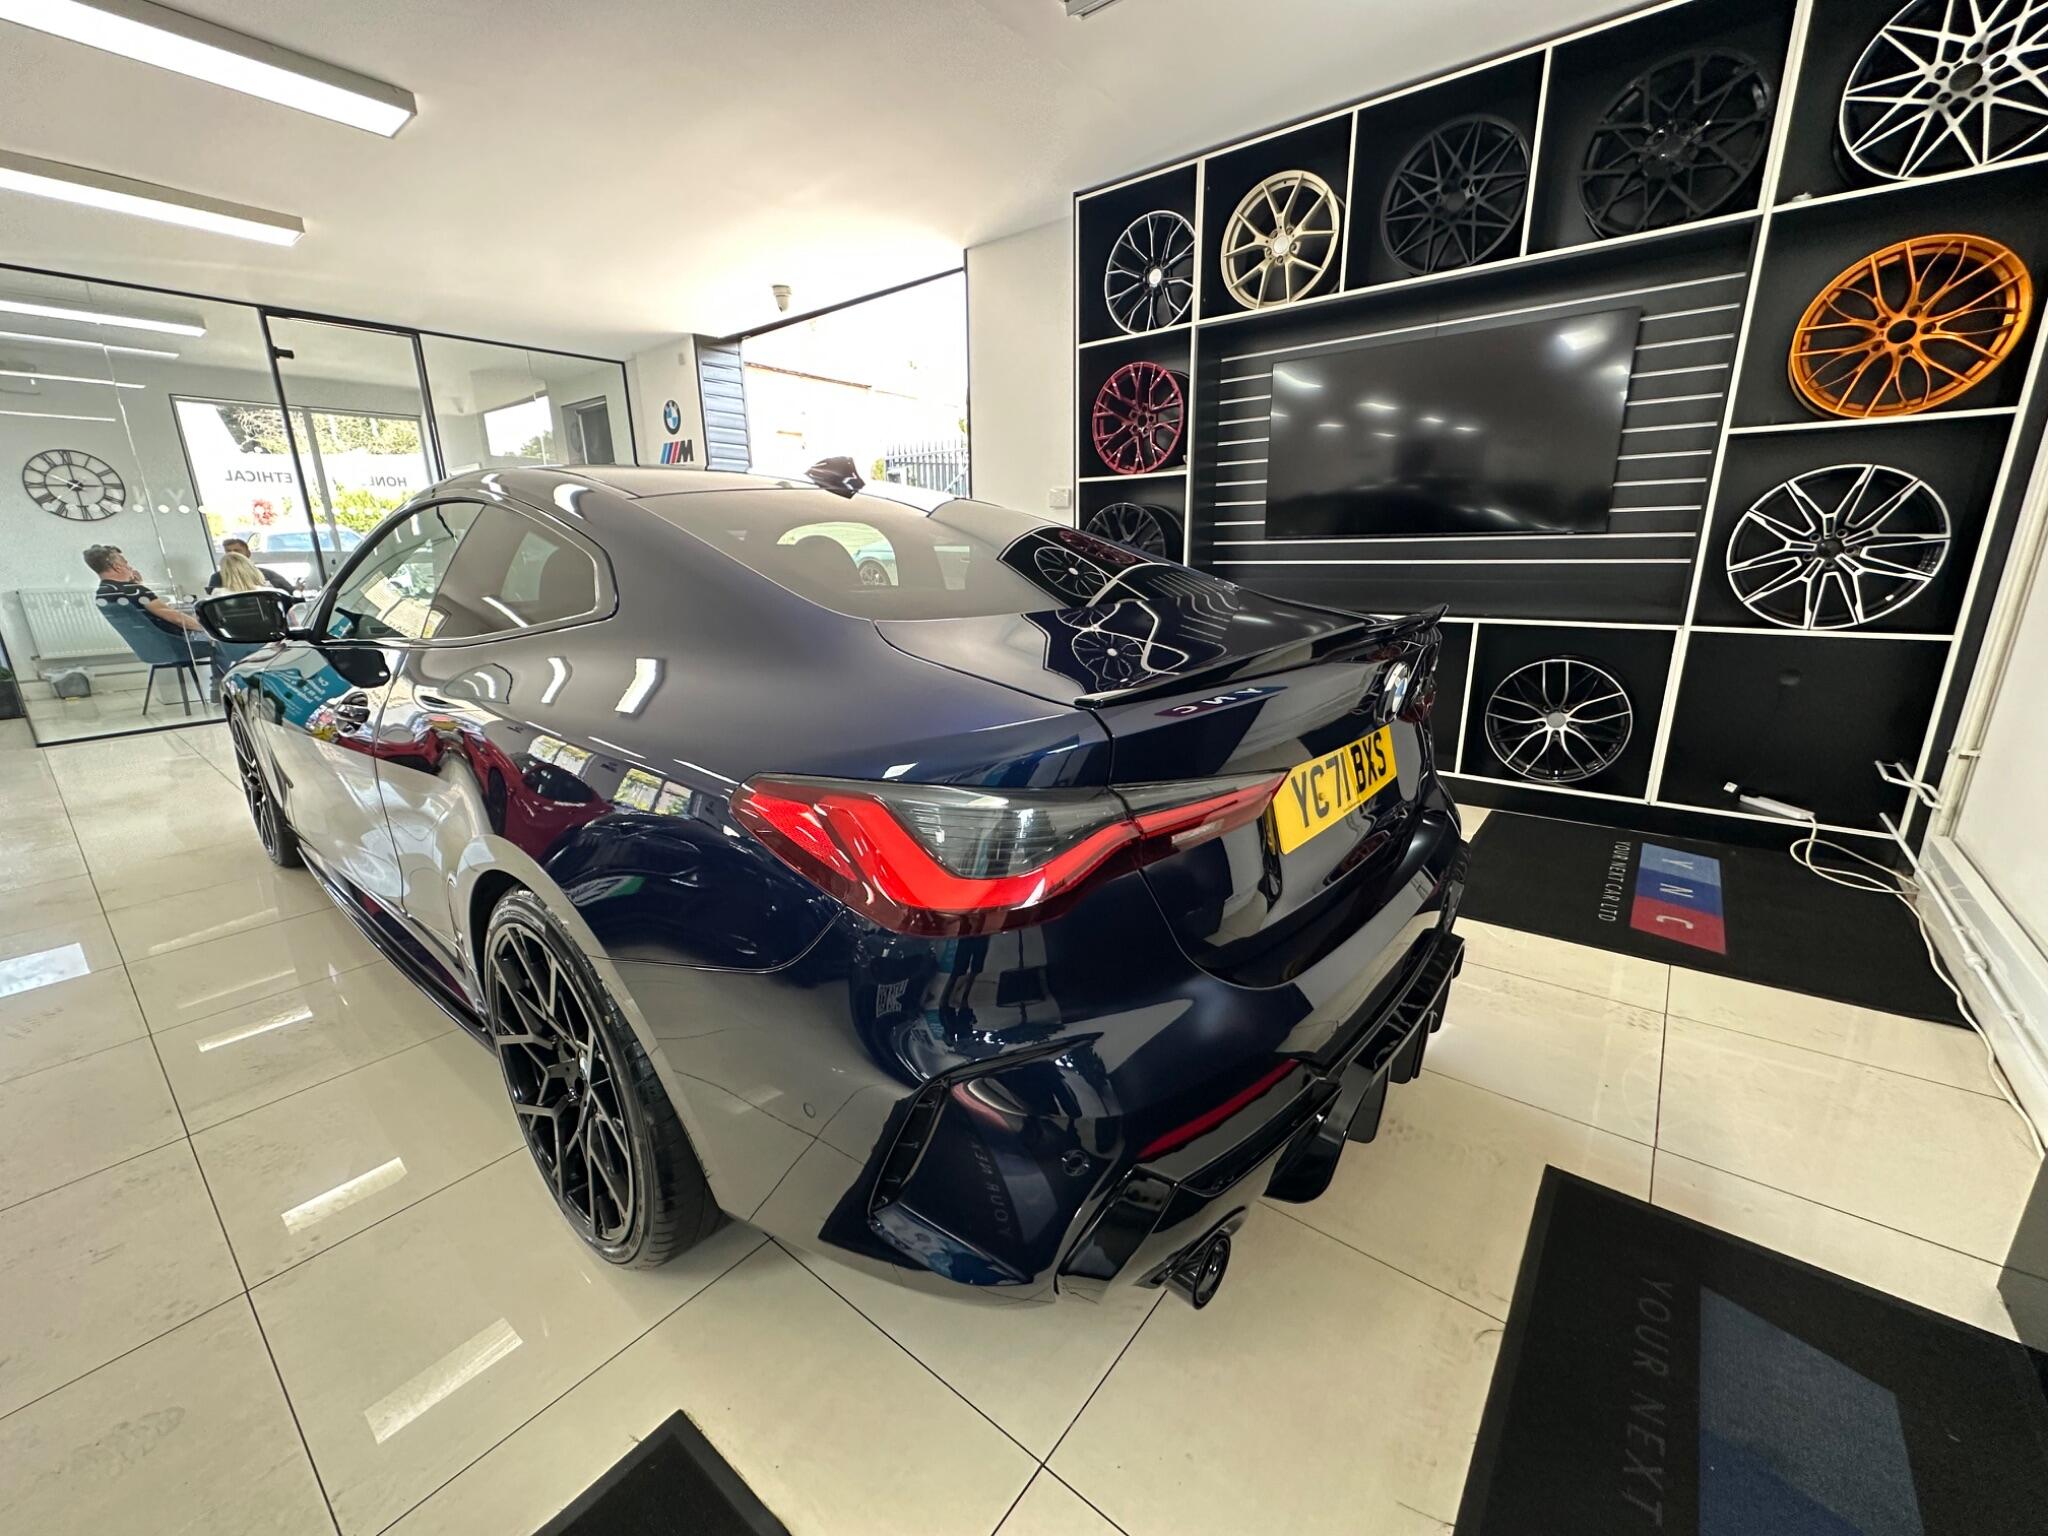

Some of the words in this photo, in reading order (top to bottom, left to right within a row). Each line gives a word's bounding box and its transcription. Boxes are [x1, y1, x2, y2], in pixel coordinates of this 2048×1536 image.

[1291, 752, 1352, 828] YC71
[1351, 731, 1387, 793] BXS
[1612, 841, 1631, 860] YOUR
[1607, 861, 1628, 883] NEXT
[1602, 883, 1623, 901] CAR
[1598, 902, 1619, 922] LTD
[1632, 1277, 1674, 1377] YOUR
[1622, 1390, 1667, 1527] NEXT
